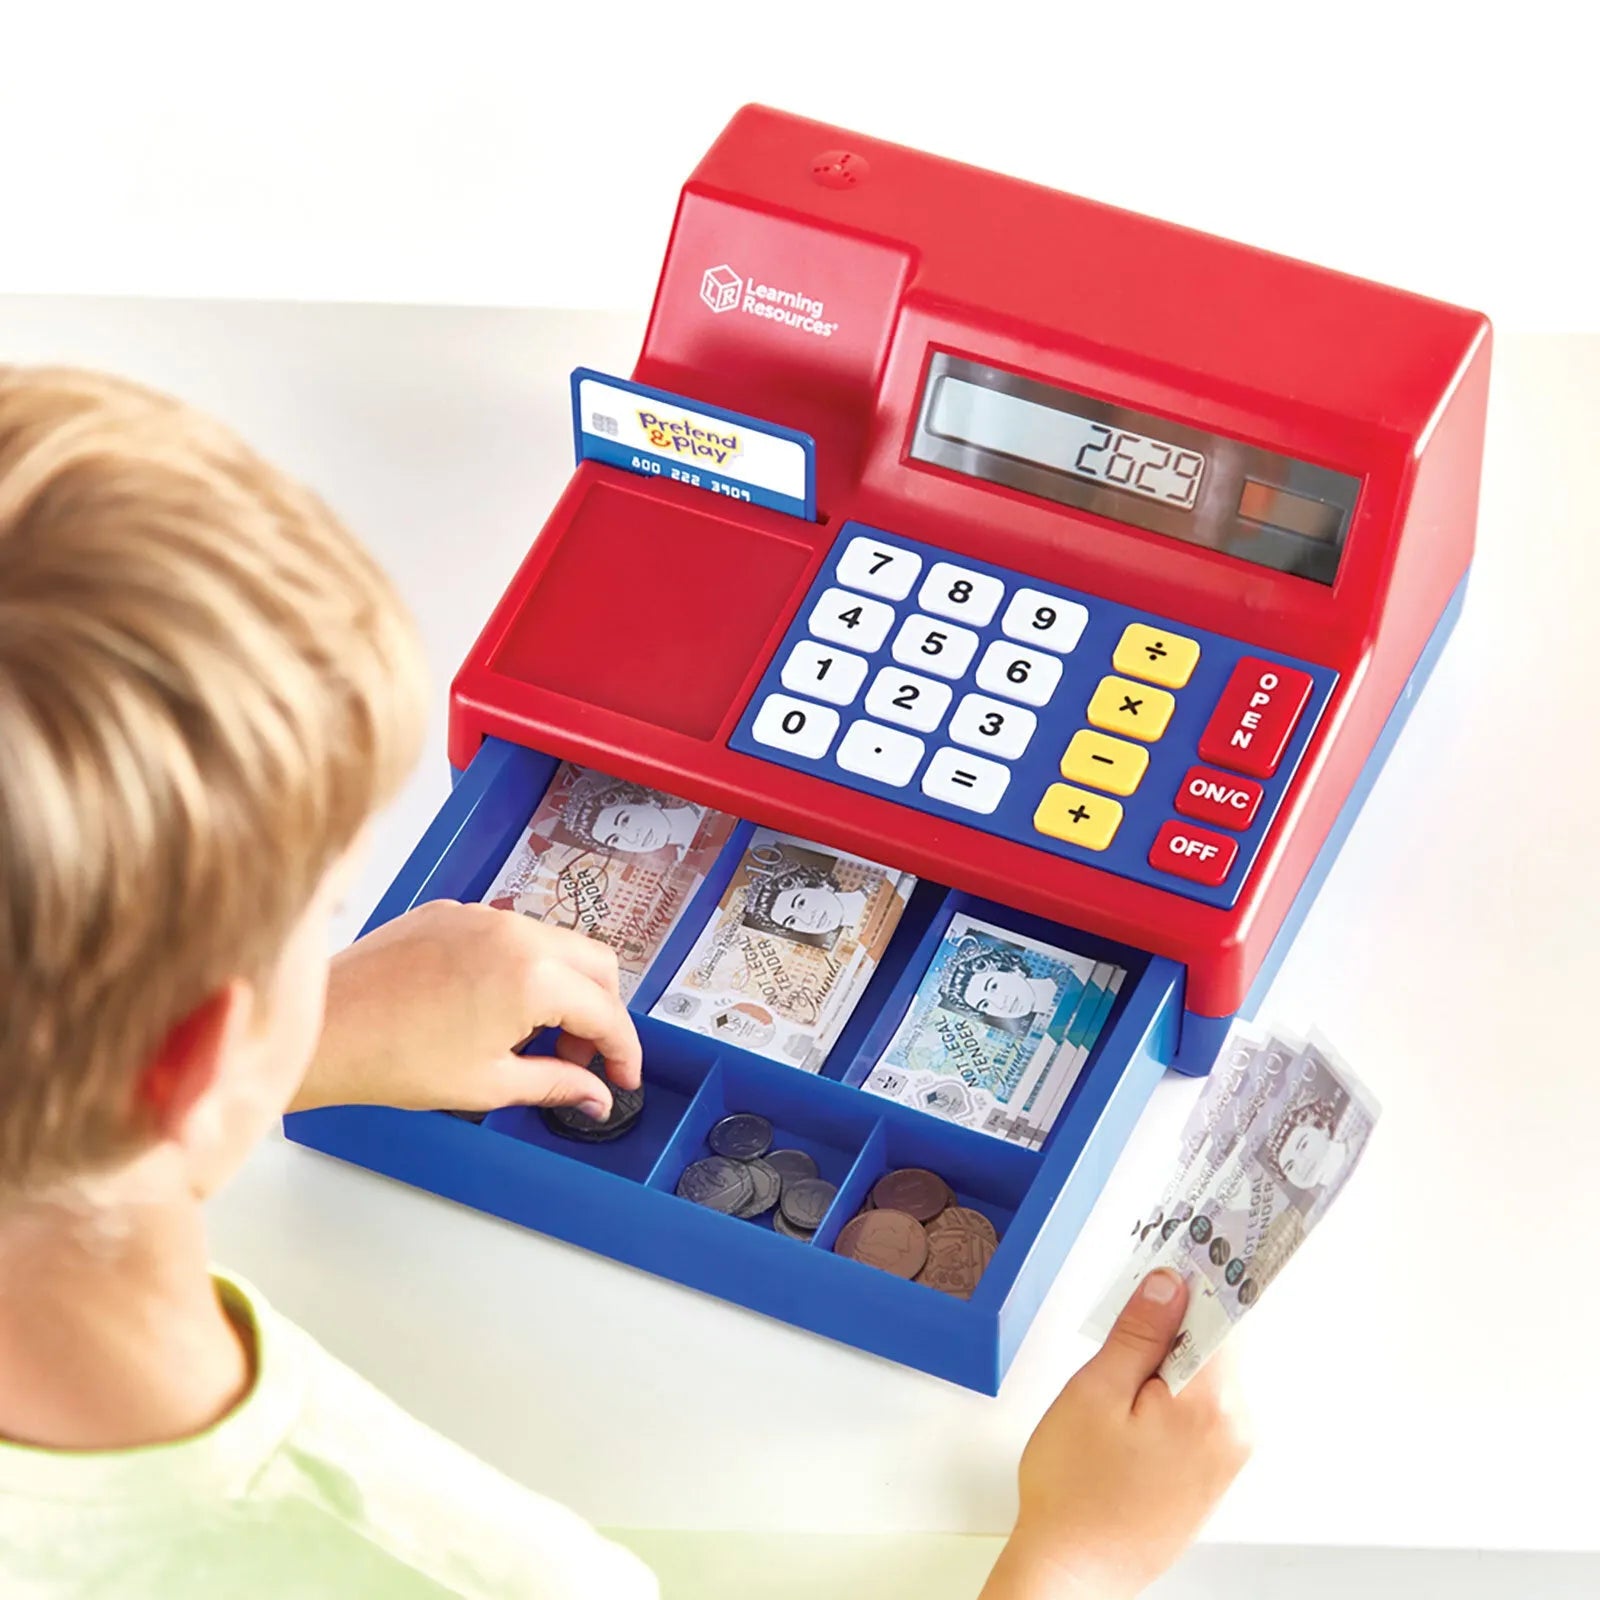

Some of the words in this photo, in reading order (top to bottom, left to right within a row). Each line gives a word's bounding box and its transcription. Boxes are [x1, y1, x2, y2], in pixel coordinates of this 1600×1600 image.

[746, 277, 824, 318] Learning
[638, 412, 737, 449] Pretend
[651, 430, 671, 447] &
[672, 436, 727, 463] Play
[1075, 425, 1203, 501] 2629
[671, 468, 700, 486] 222
[868, 552, 893, 575] 7
[948, 580, 973, 603] 8
[838, 607, 863, 629] 4
[1032, 607, 1057, 630] 9
[921, 632, 947, 655] 5
[817, 659, 833, 681] 1
[1006, 660, 1032, 683] 6
[893, 685, 920, 709] 2
[782, 711, 806, 734] 0
[978, 713, 1004, 736] 3
[1230, 673, 1279, 749] OPEN
[1189, 779, 1250, 810] ON/C
[746, 844, 783, 879] 10
[1169, 835, 1219, 861] OFF
[578, 868, 611, 920] TENDER
[578, 907, 598, 932] NOT
[738, 935, 767, 982] LEGAL
[757, 939, 790, 992] TENDER
[757, 981, 778, 1006] NOT
[934, 1015, 964, 1060] LEGAL
[954, 1020, 991, 1074] TENDER
[956, 1061, 979, 1088] NOT
[1247, 1173, 1264, 1232] LEGAL
[1257, 1182, 1275, 1251] TENDER
